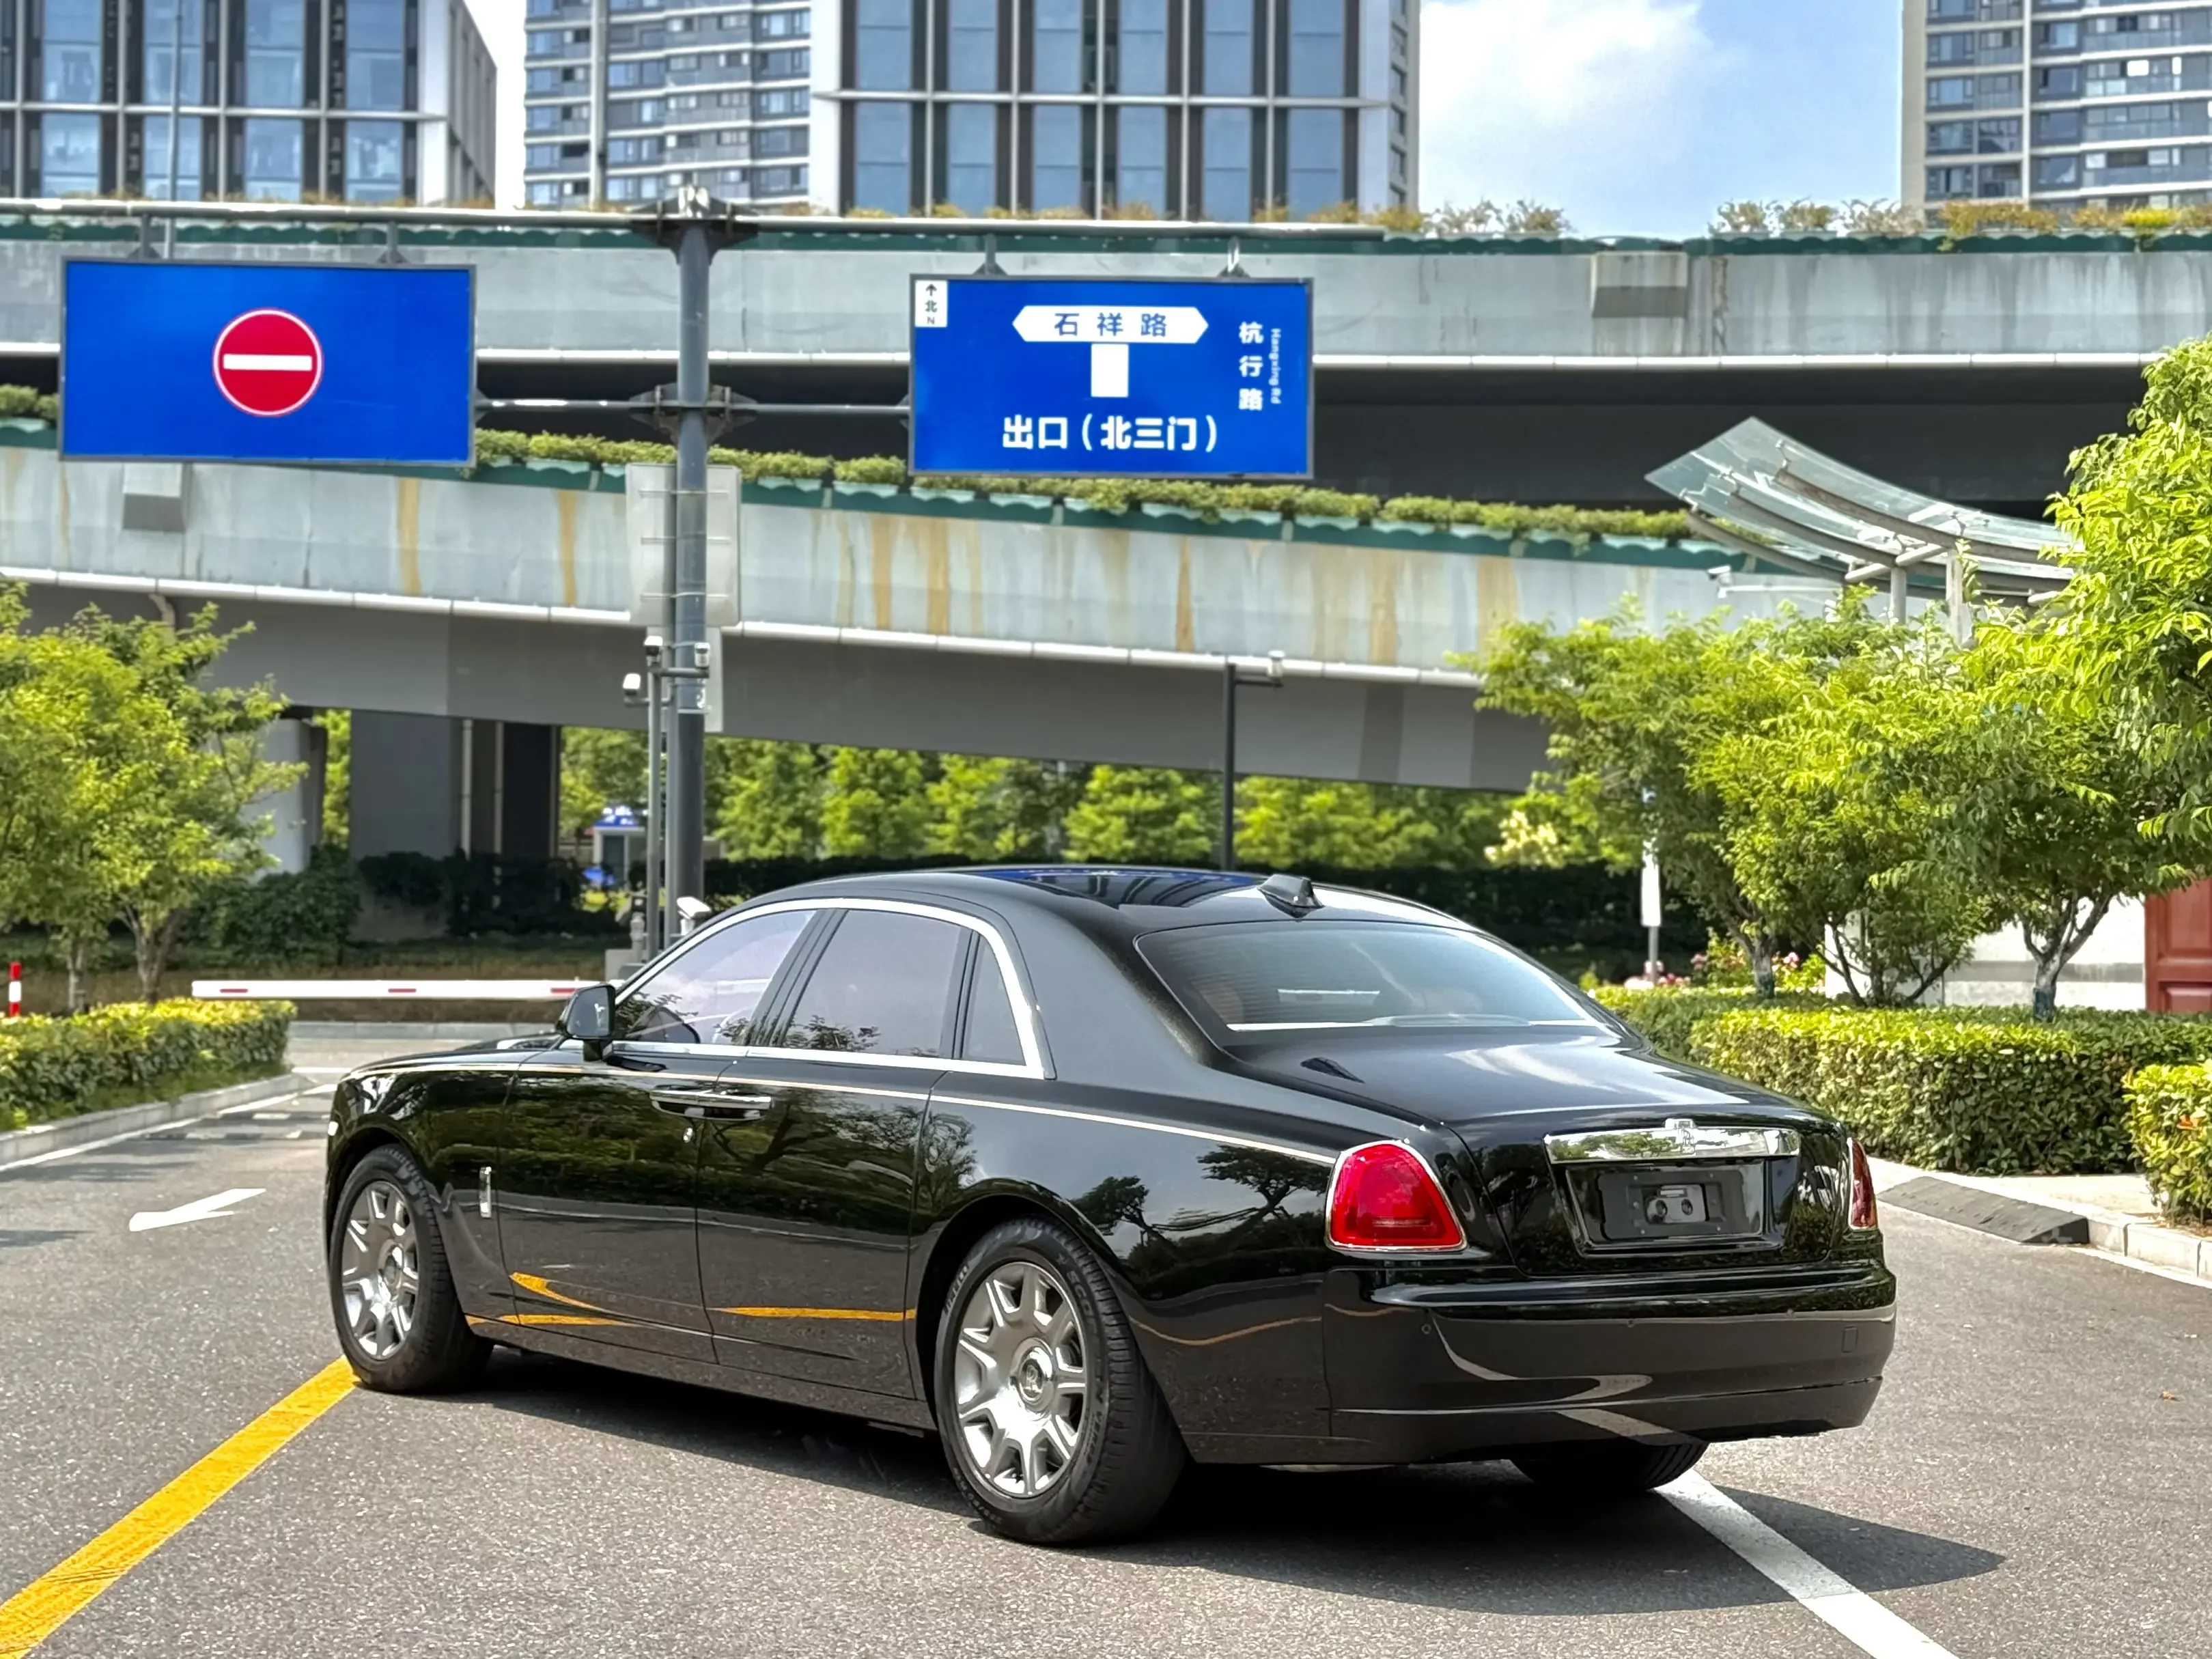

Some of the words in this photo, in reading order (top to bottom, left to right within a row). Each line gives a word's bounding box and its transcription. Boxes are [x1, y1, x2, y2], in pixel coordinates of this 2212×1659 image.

[925, 300, 938, 313] 北
[927, 316, 936, 325] N
[1054, 312, 1167, 337] 石祥路
[1238, 322, 1264, 410] 杭行路
